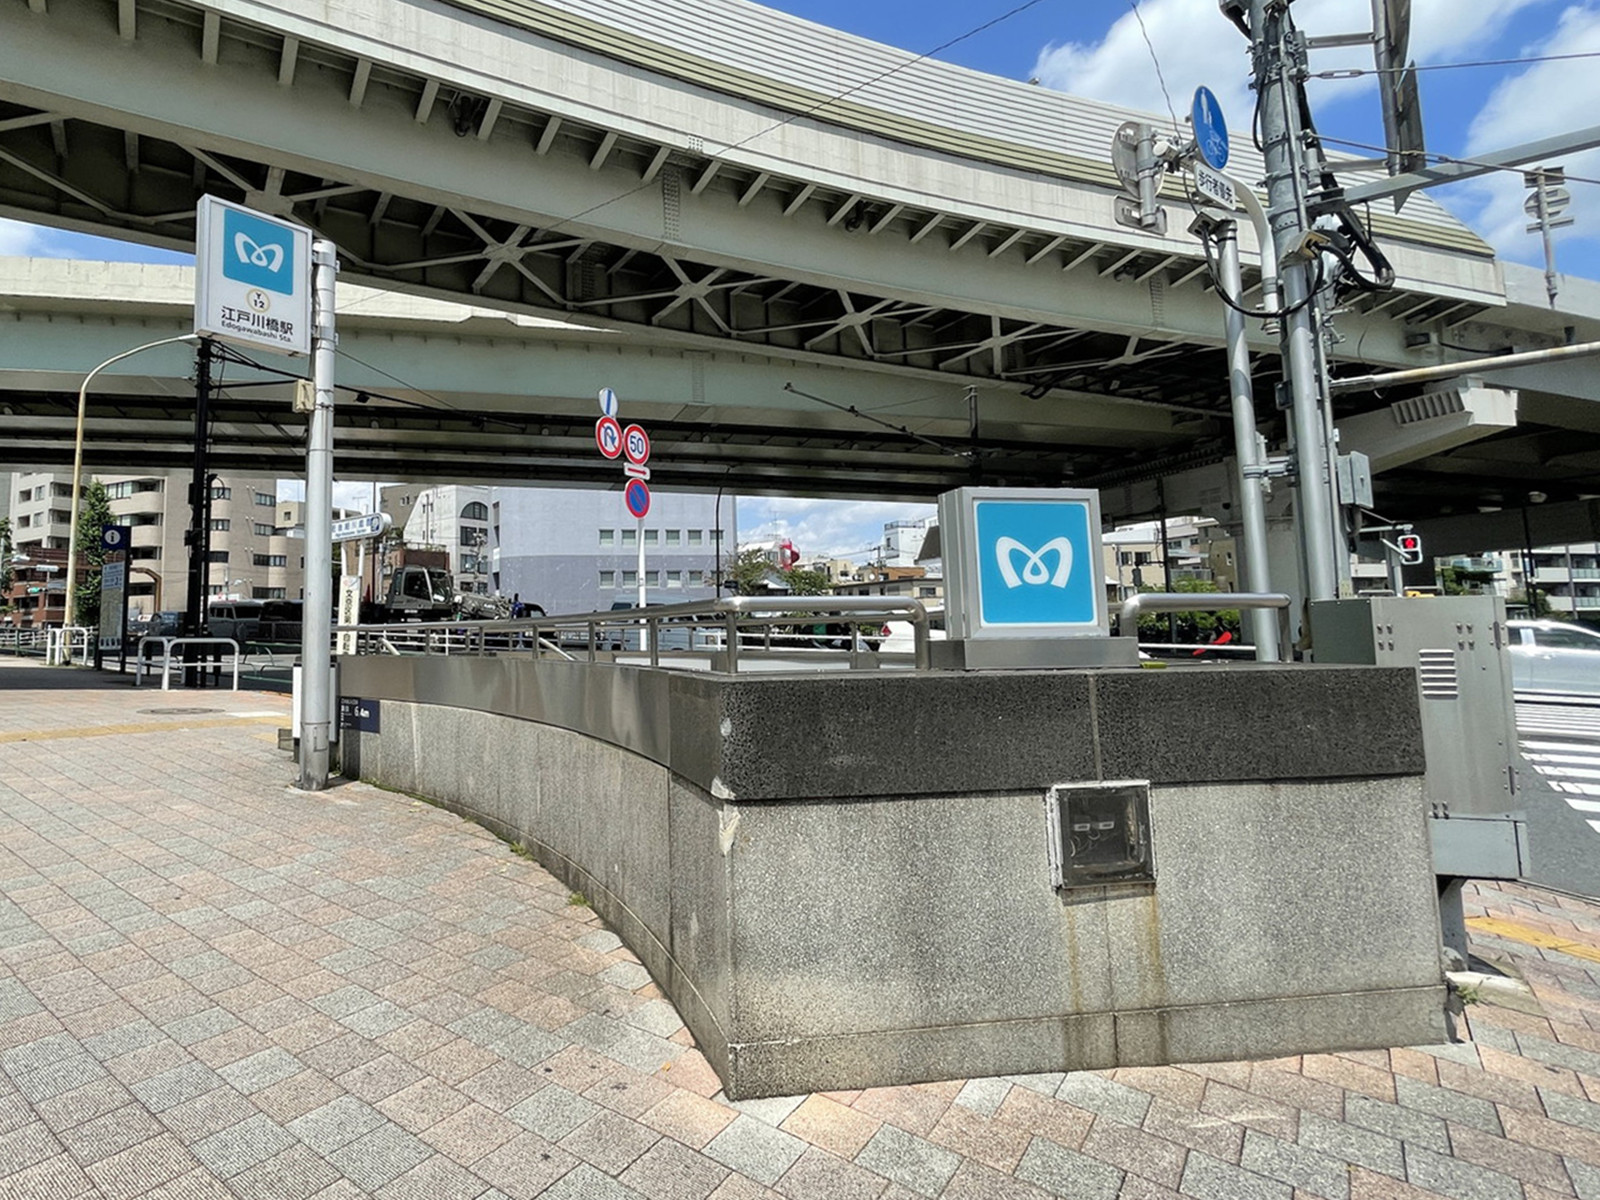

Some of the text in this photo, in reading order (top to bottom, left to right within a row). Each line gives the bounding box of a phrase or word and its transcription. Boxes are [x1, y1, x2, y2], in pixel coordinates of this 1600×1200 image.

[253, 299, 265, 309] 12
[255, 292, 261, 300] Y
[221, 305, 294, 336] 江戸川橋駅
[221, 320, 277, 340] Edogawabashi
[630, 434, 644, 455] 50
